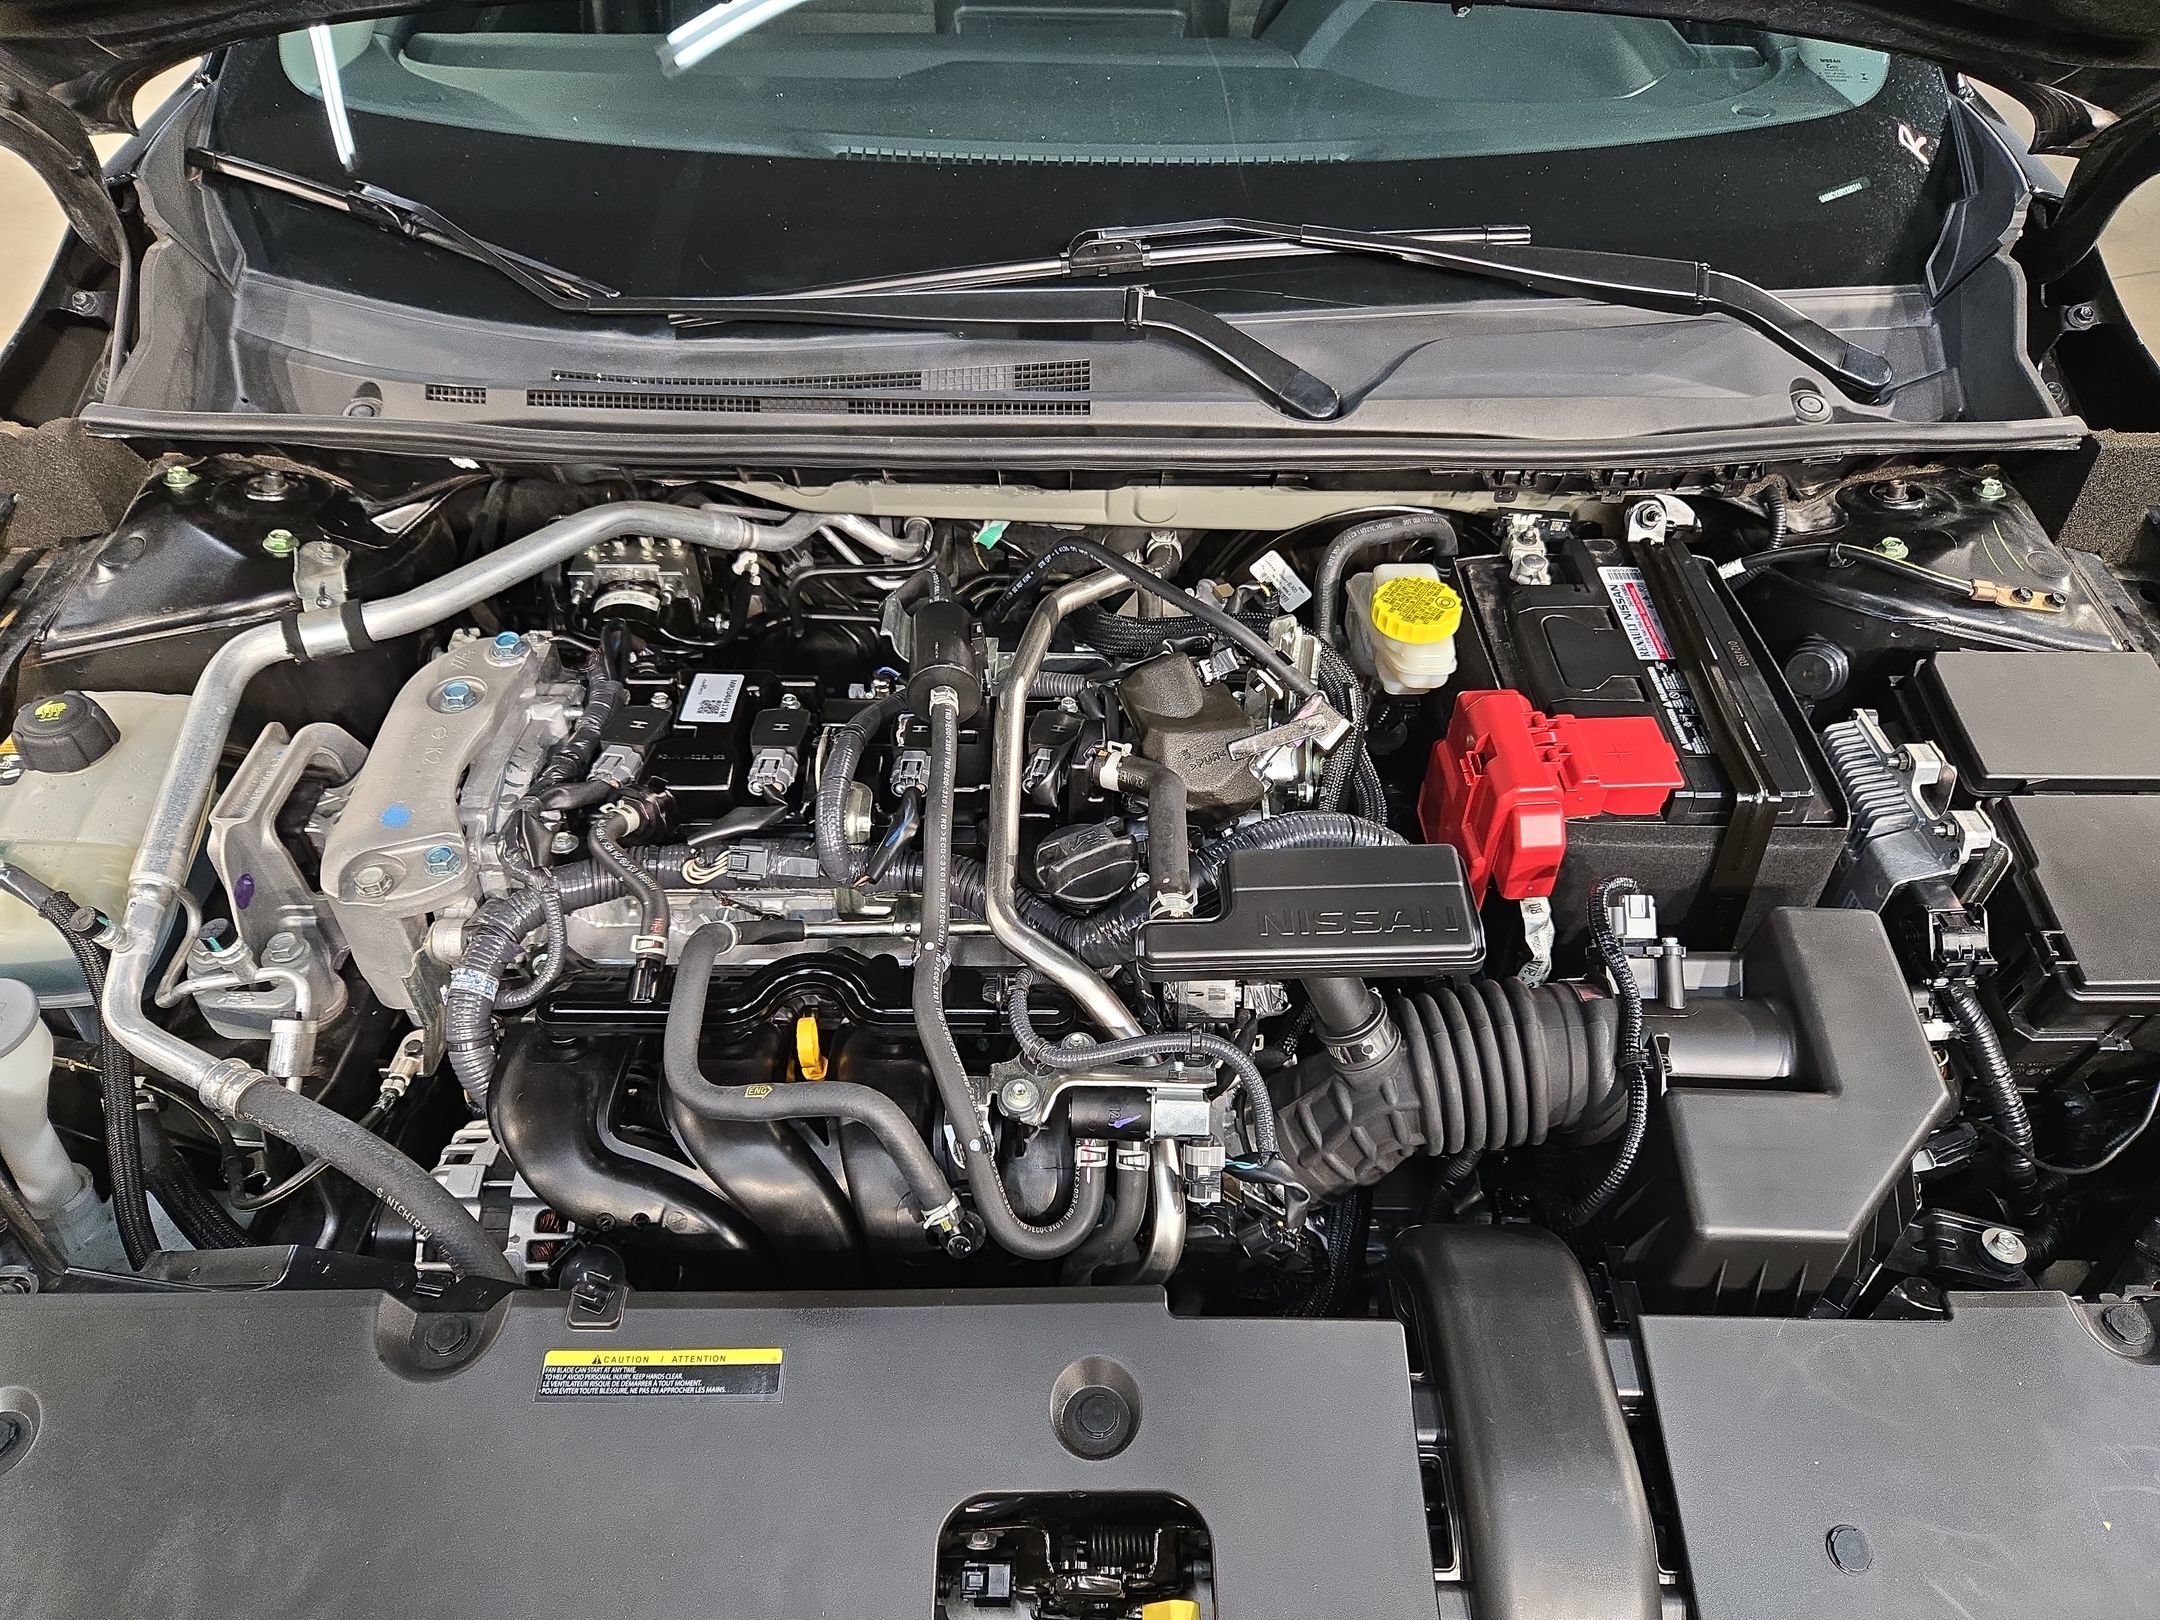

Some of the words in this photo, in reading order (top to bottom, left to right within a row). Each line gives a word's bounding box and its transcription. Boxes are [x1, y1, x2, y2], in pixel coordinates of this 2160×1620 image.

[1608, 584, 1633, 620] NISSAN
[1626, 620, 1651, 658] RENAULT
[1257, 908, 1459, 936] NISSAN
[747, 1085, 768, 1096] ENG
[603, 1355, 650, 1364] CAUTION
[671, 1354, 727, 1363] ATTENTION
